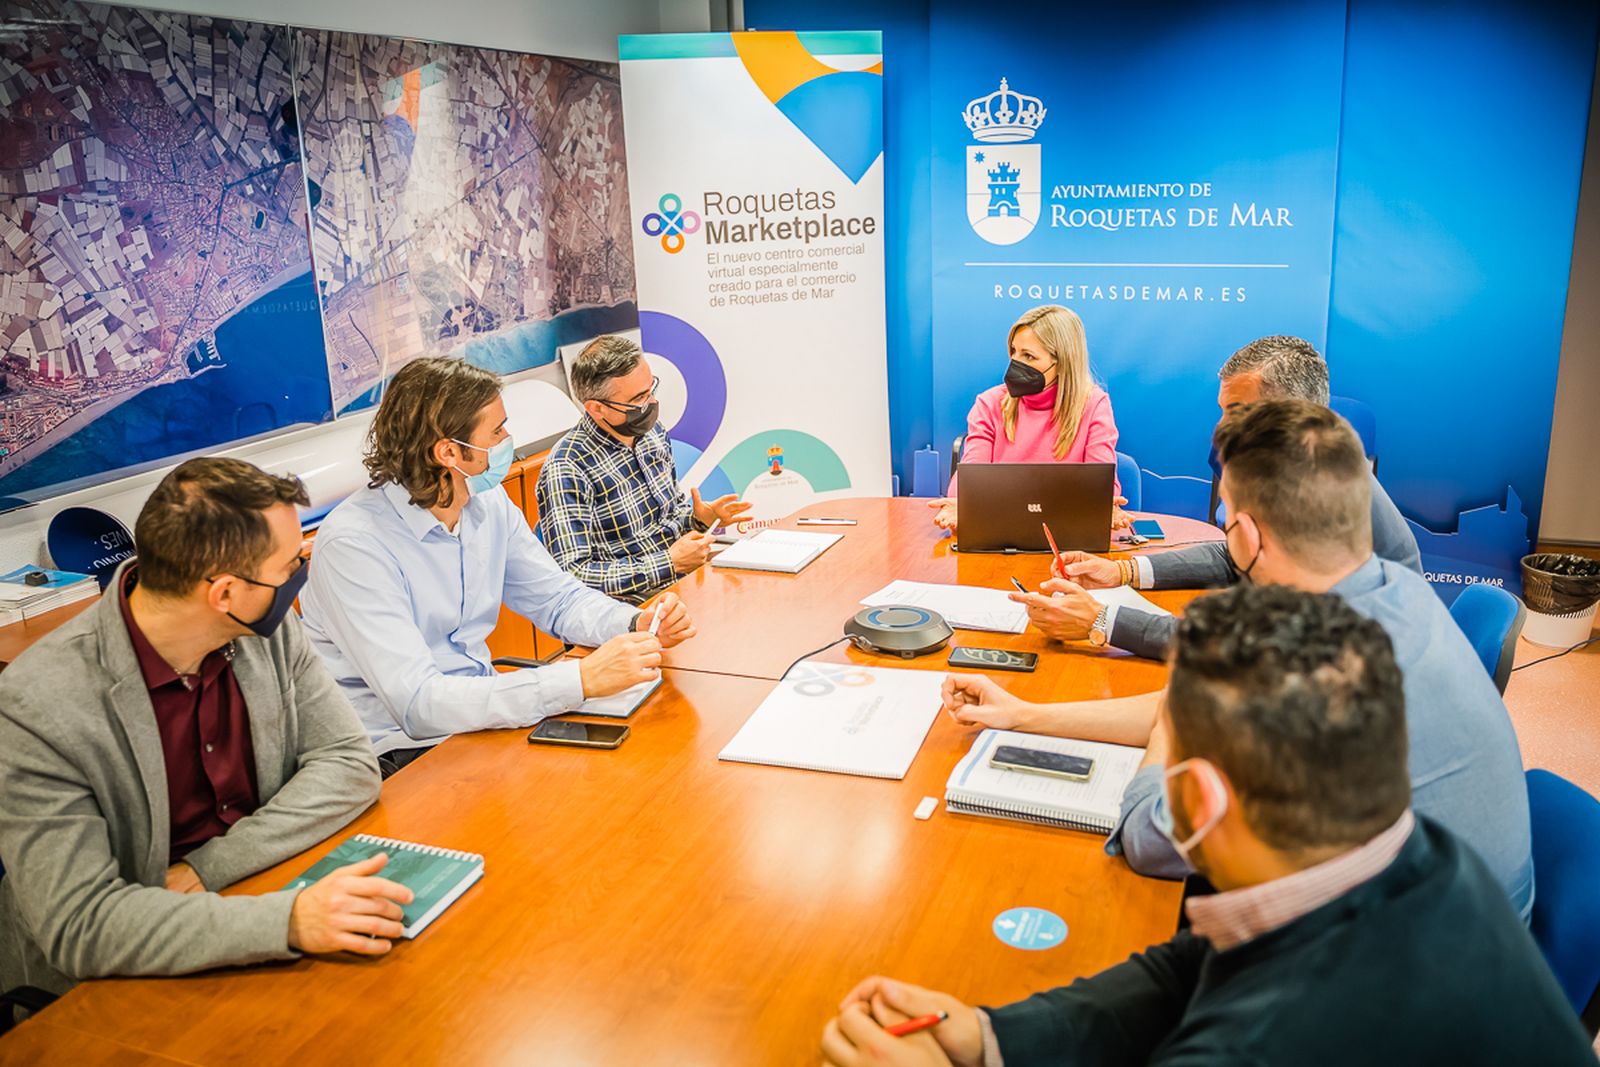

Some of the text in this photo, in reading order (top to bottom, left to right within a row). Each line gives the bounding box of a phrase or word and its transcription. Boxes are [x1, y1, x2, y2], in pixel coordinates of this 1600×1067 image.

[1051, 183, 1212, 199] AYUNTAMIENTO DE
[703, 187, 836, 218] Roquetas
[705, 213, 876, 245] Marketplace
[707, 243, 865, 265] El nuevo centro comercial
[707, 260, 838, 279] virtual especialmente
[708, 272, 857, 293] creado para el comercio
[994, 284, 1247, 302] ROQUETASDEMAR.ES
[709, 287, 835, 308] de Roquetas de Mar
[1423, 571, 1504, 588] QUETAS DE MAR
